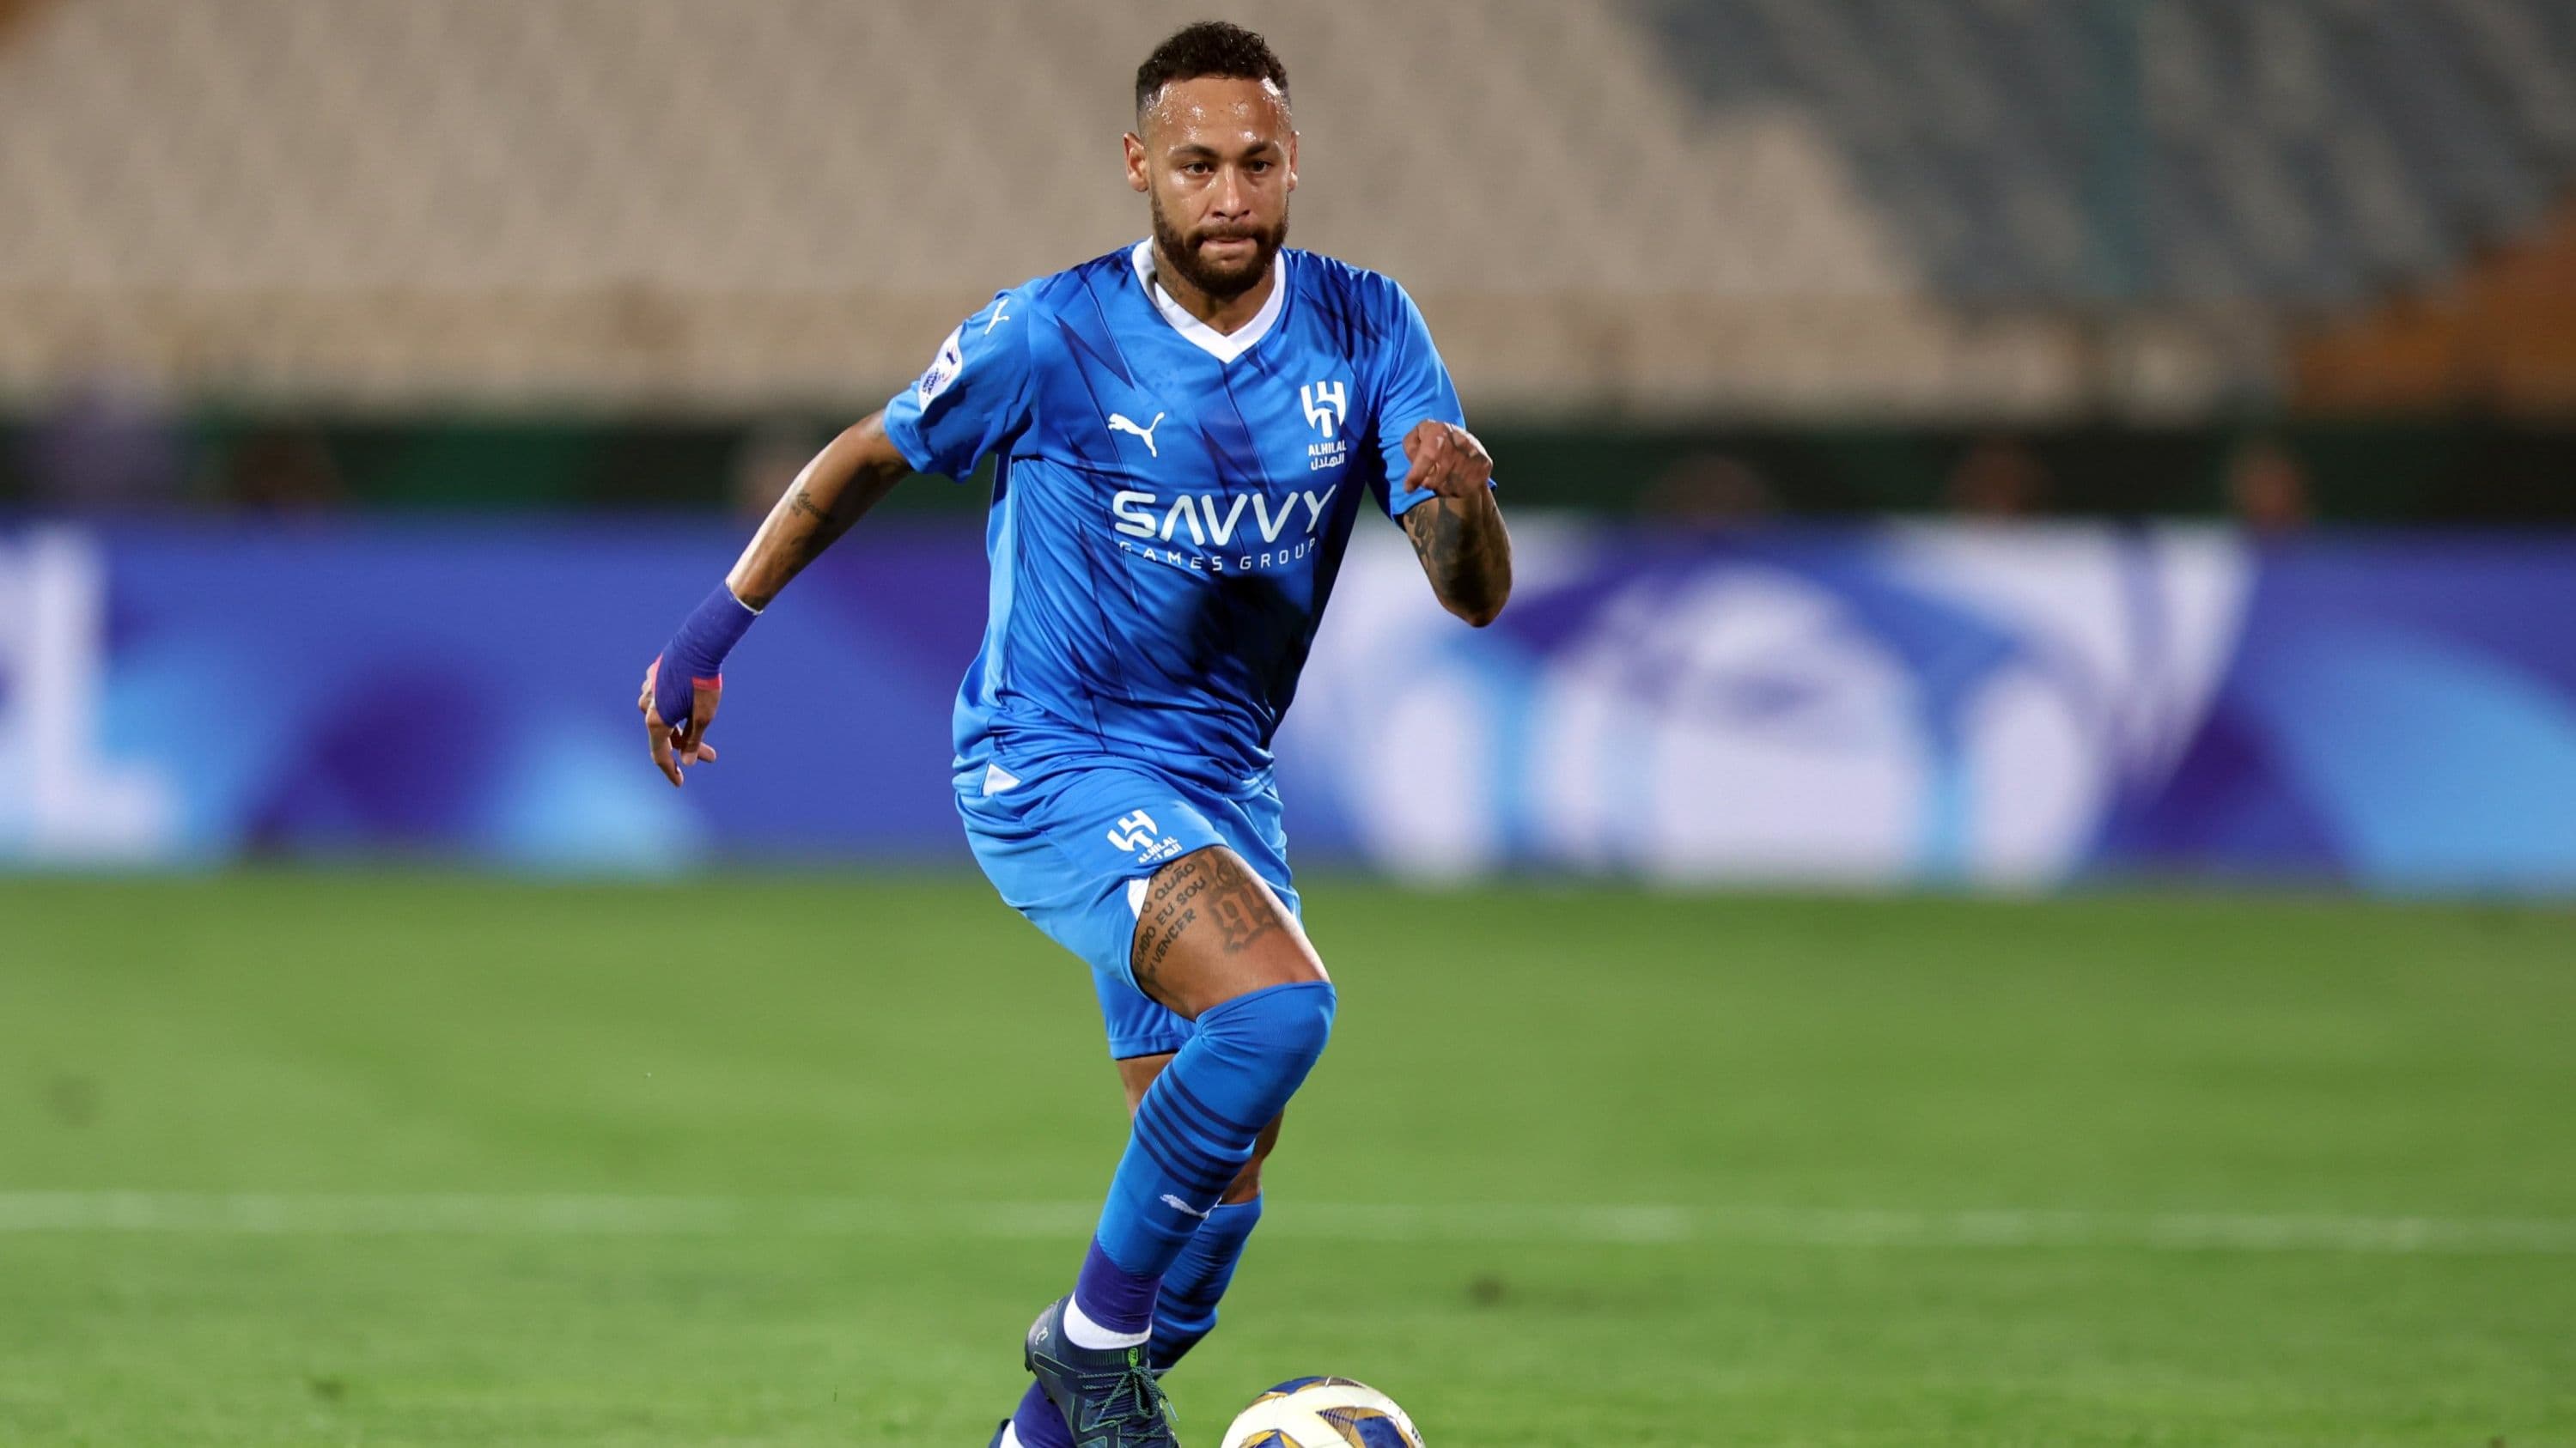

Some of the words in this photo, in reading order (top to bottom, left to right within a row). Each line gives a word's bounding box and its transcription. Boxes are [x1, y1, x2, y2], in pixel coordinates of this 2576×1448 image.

[1308, 440, 1347, 456] ALHILAL
[1112, 484, 1336, 546] SAVVY
[1119, 541, 1222, 571] GAMES
[1239, 538, 1316, 569] GROUP
[1155, 902, 1175, 926] EU
[1176, 877, 1206, 905] SOU
[1152, 908, 1197, 963] VENCER
